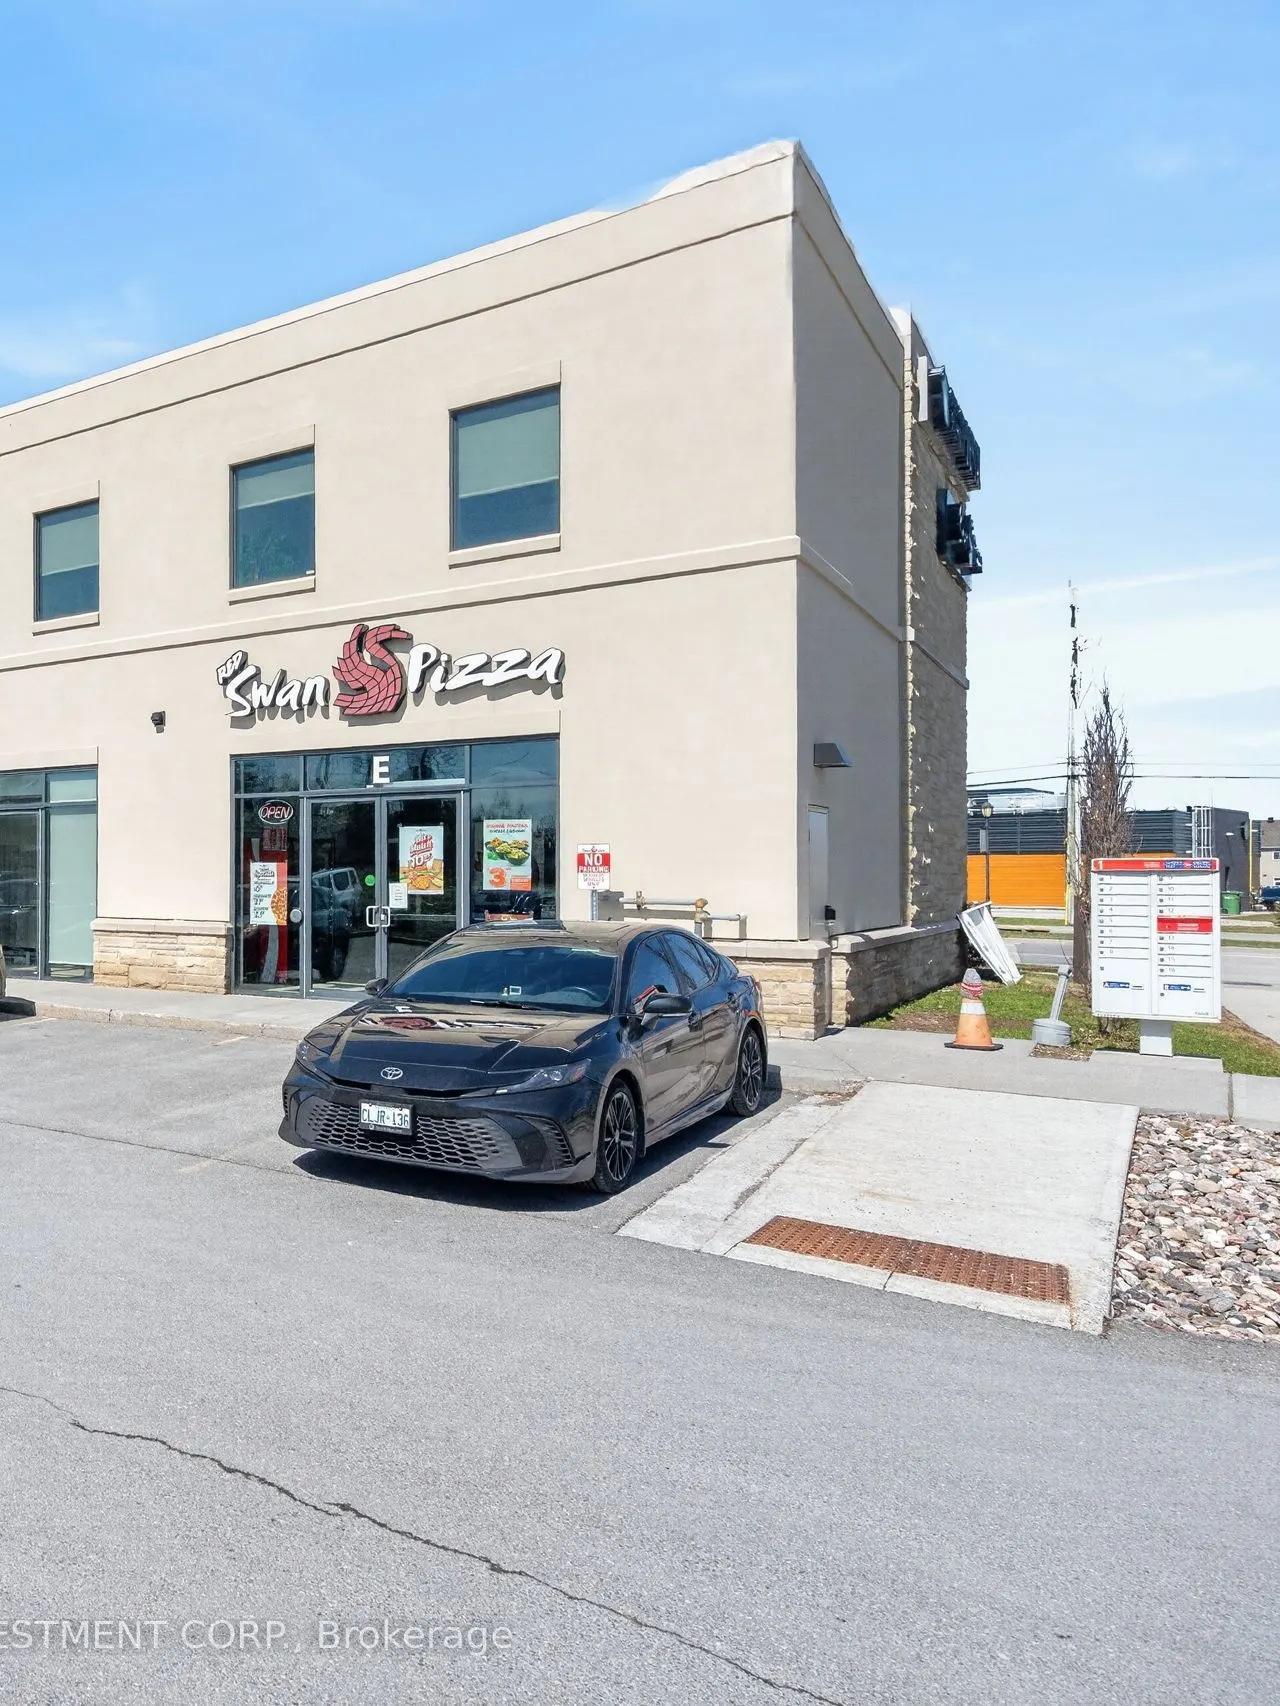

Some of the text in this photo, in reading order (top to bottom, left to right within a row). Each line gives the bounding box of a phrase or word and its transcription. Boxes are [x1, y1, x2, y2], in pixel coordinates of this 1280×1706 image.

[217, 650, 244, 685] RED
[225, 643, 564, 717] Swan Pizza
[373, 756, 390, 784] E
[261, 806, 290, 818] OPEN
[584, 854, 603, 866] NO
[489, 867, 506, 888] 3
